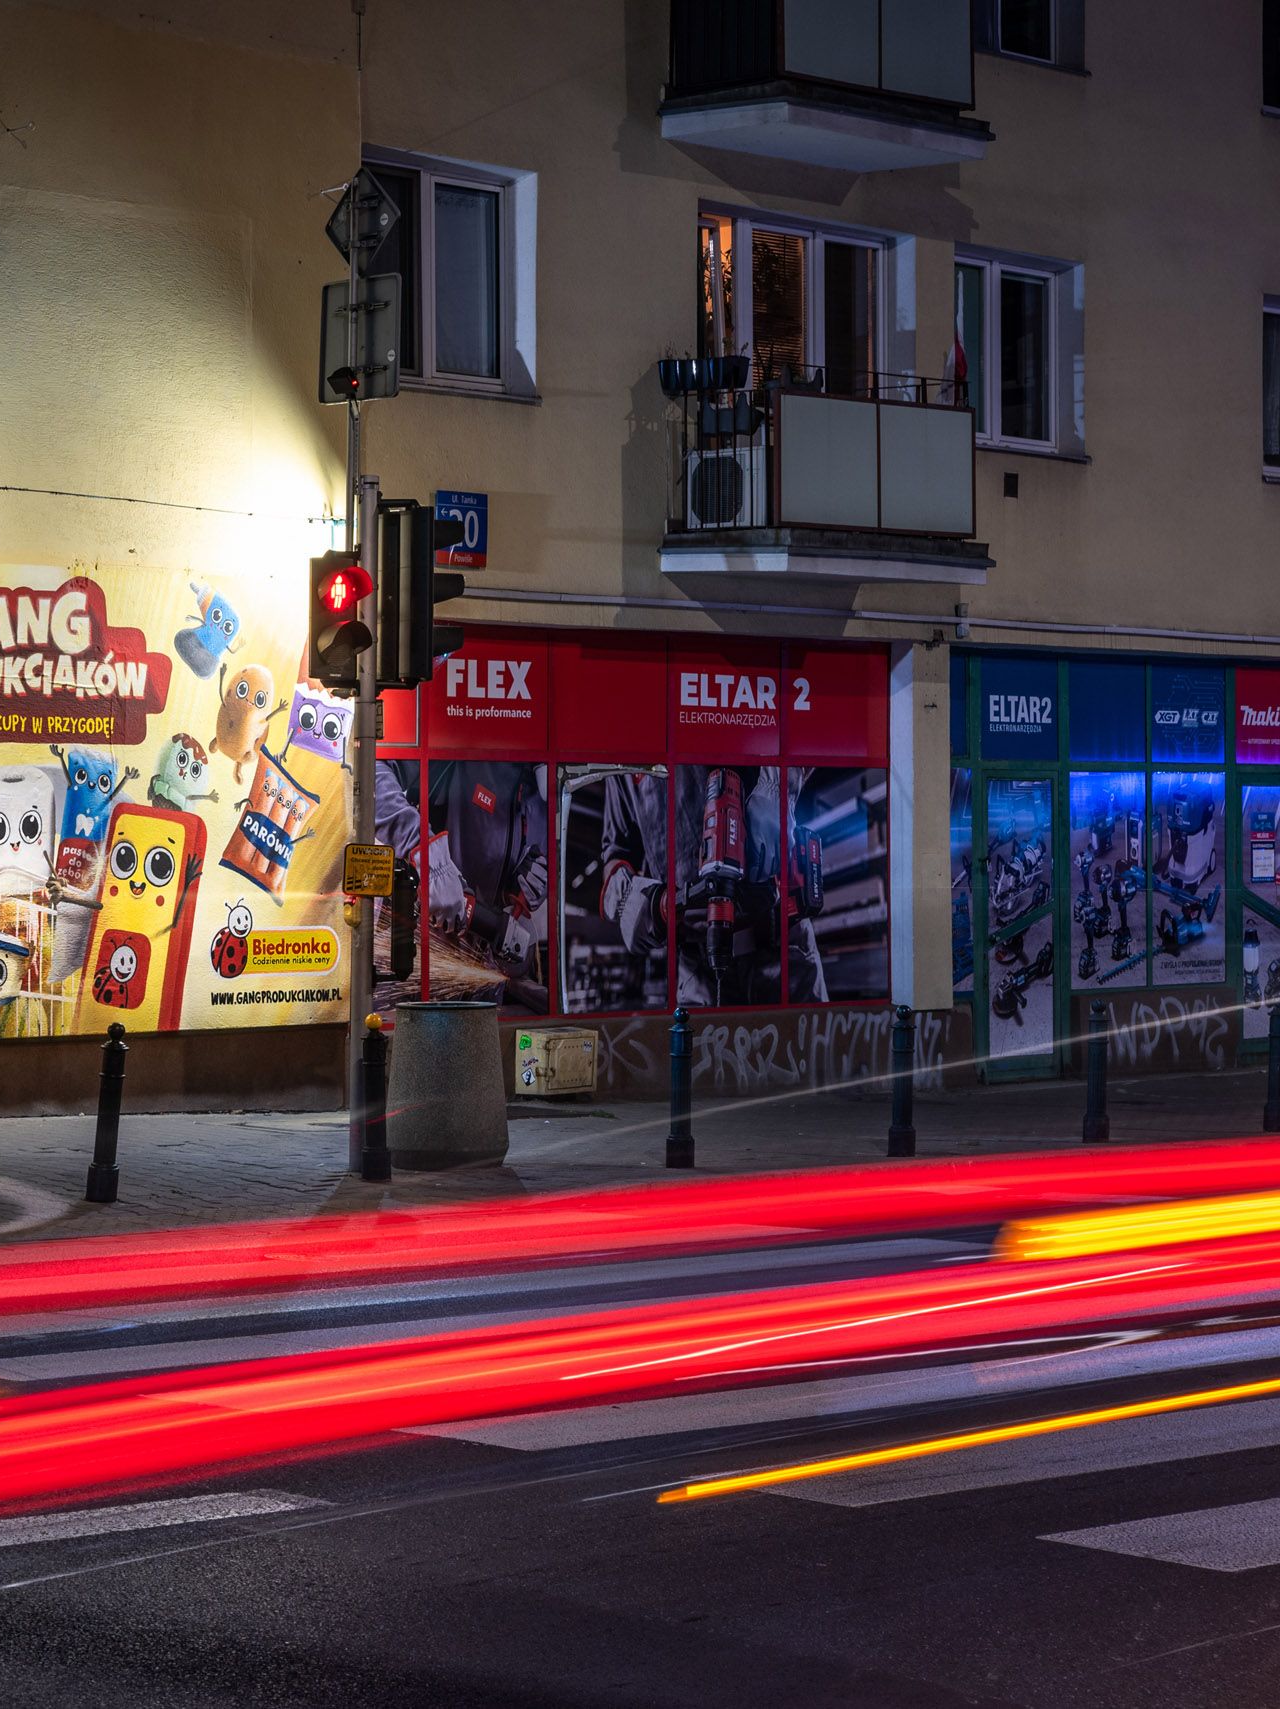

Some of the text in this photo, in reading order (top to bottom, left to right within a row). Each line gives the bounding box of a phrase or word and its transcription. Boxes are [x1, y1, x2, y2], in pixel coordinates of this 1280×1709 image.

[447, 658, 532, 700] FLEX
[680, 672, 811, 711] ELTAR 2
[447, 704, 532, 720] this is proformance
[989, 694, 1052, 724] ELTAR2
[1159, 711, 1179, 722] XGT
[32, 716, 43, 734] W
[47, 716, 115, 739] PRZYGODĘ!
[679, 711, 777, 728] ELEKTRONARZĘDZIA
[477, 791, 493, 807] FLEX
[729, 817, 738, 846] FLEX
[68, 857, 82, 868] do
[252, 937, 331, 956] Biedronka
[252, 956, 331, 966] Codziennie niskie ceny
[211, 987, 342, 1006] WWW.GANGPRODUKCIAKOW.PL
